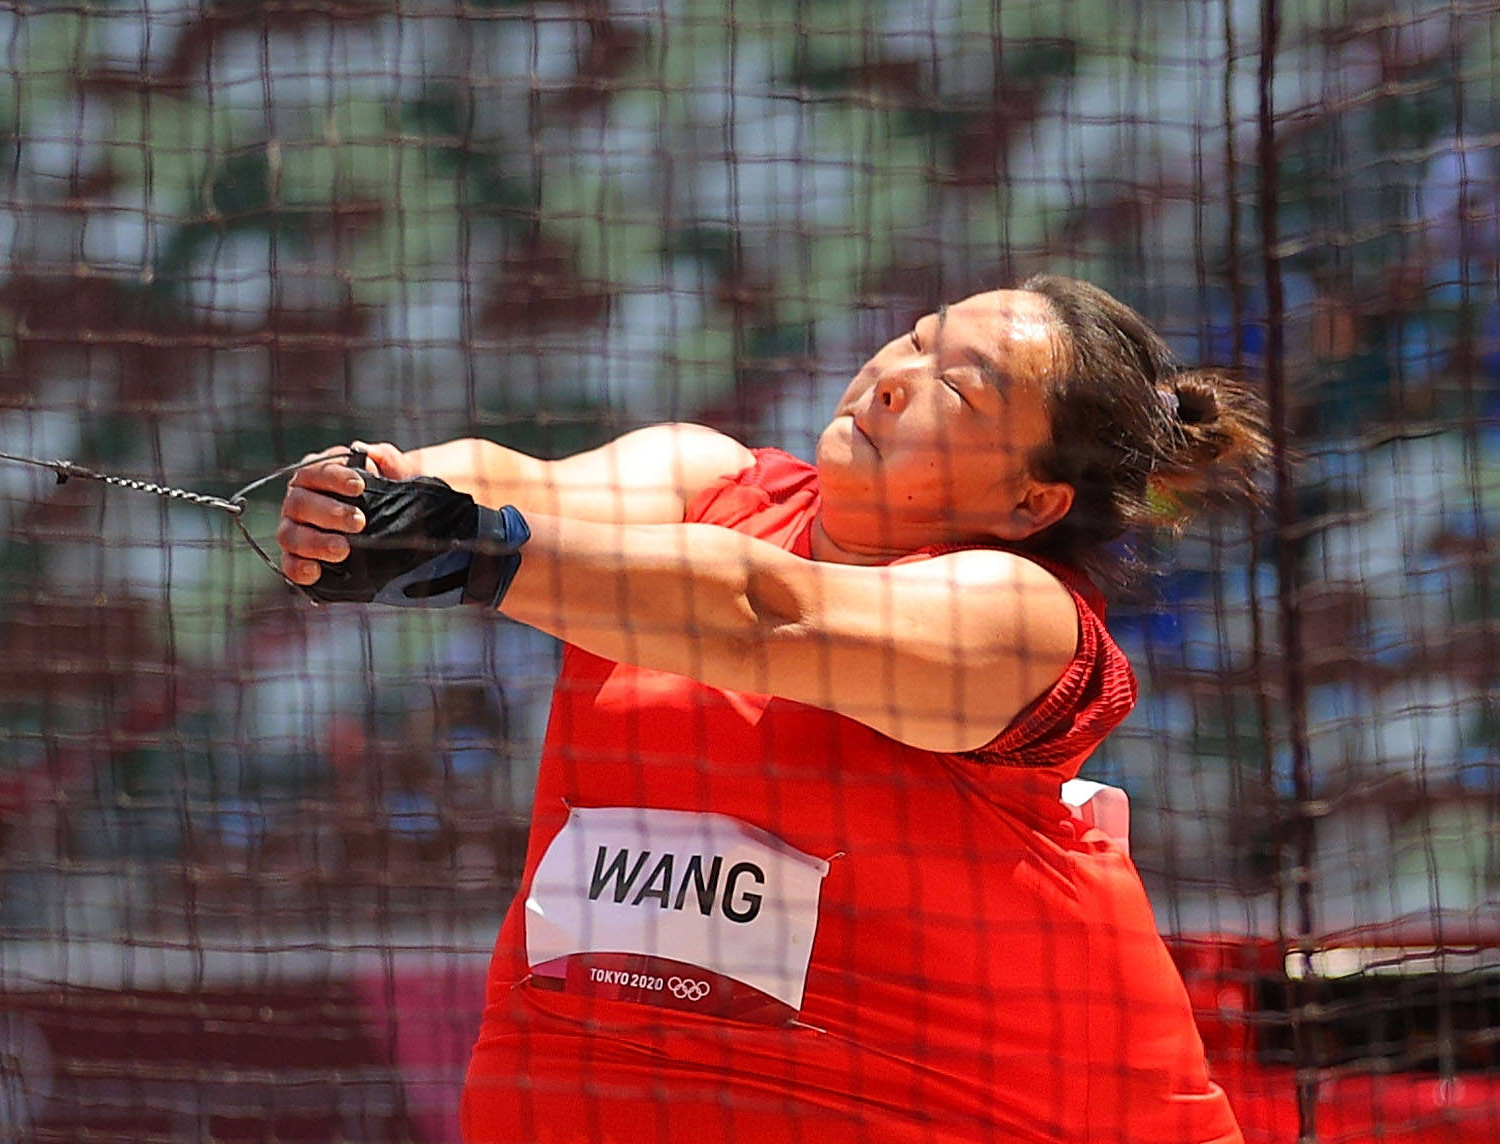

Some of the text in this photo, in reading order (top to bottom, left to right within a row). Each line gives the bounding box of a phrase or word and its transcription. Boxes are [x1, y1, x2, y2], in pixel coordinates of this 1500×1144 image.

[588, 845, 766, 923] WANG
[590, 968, 664, 991] TOKYO 2020
